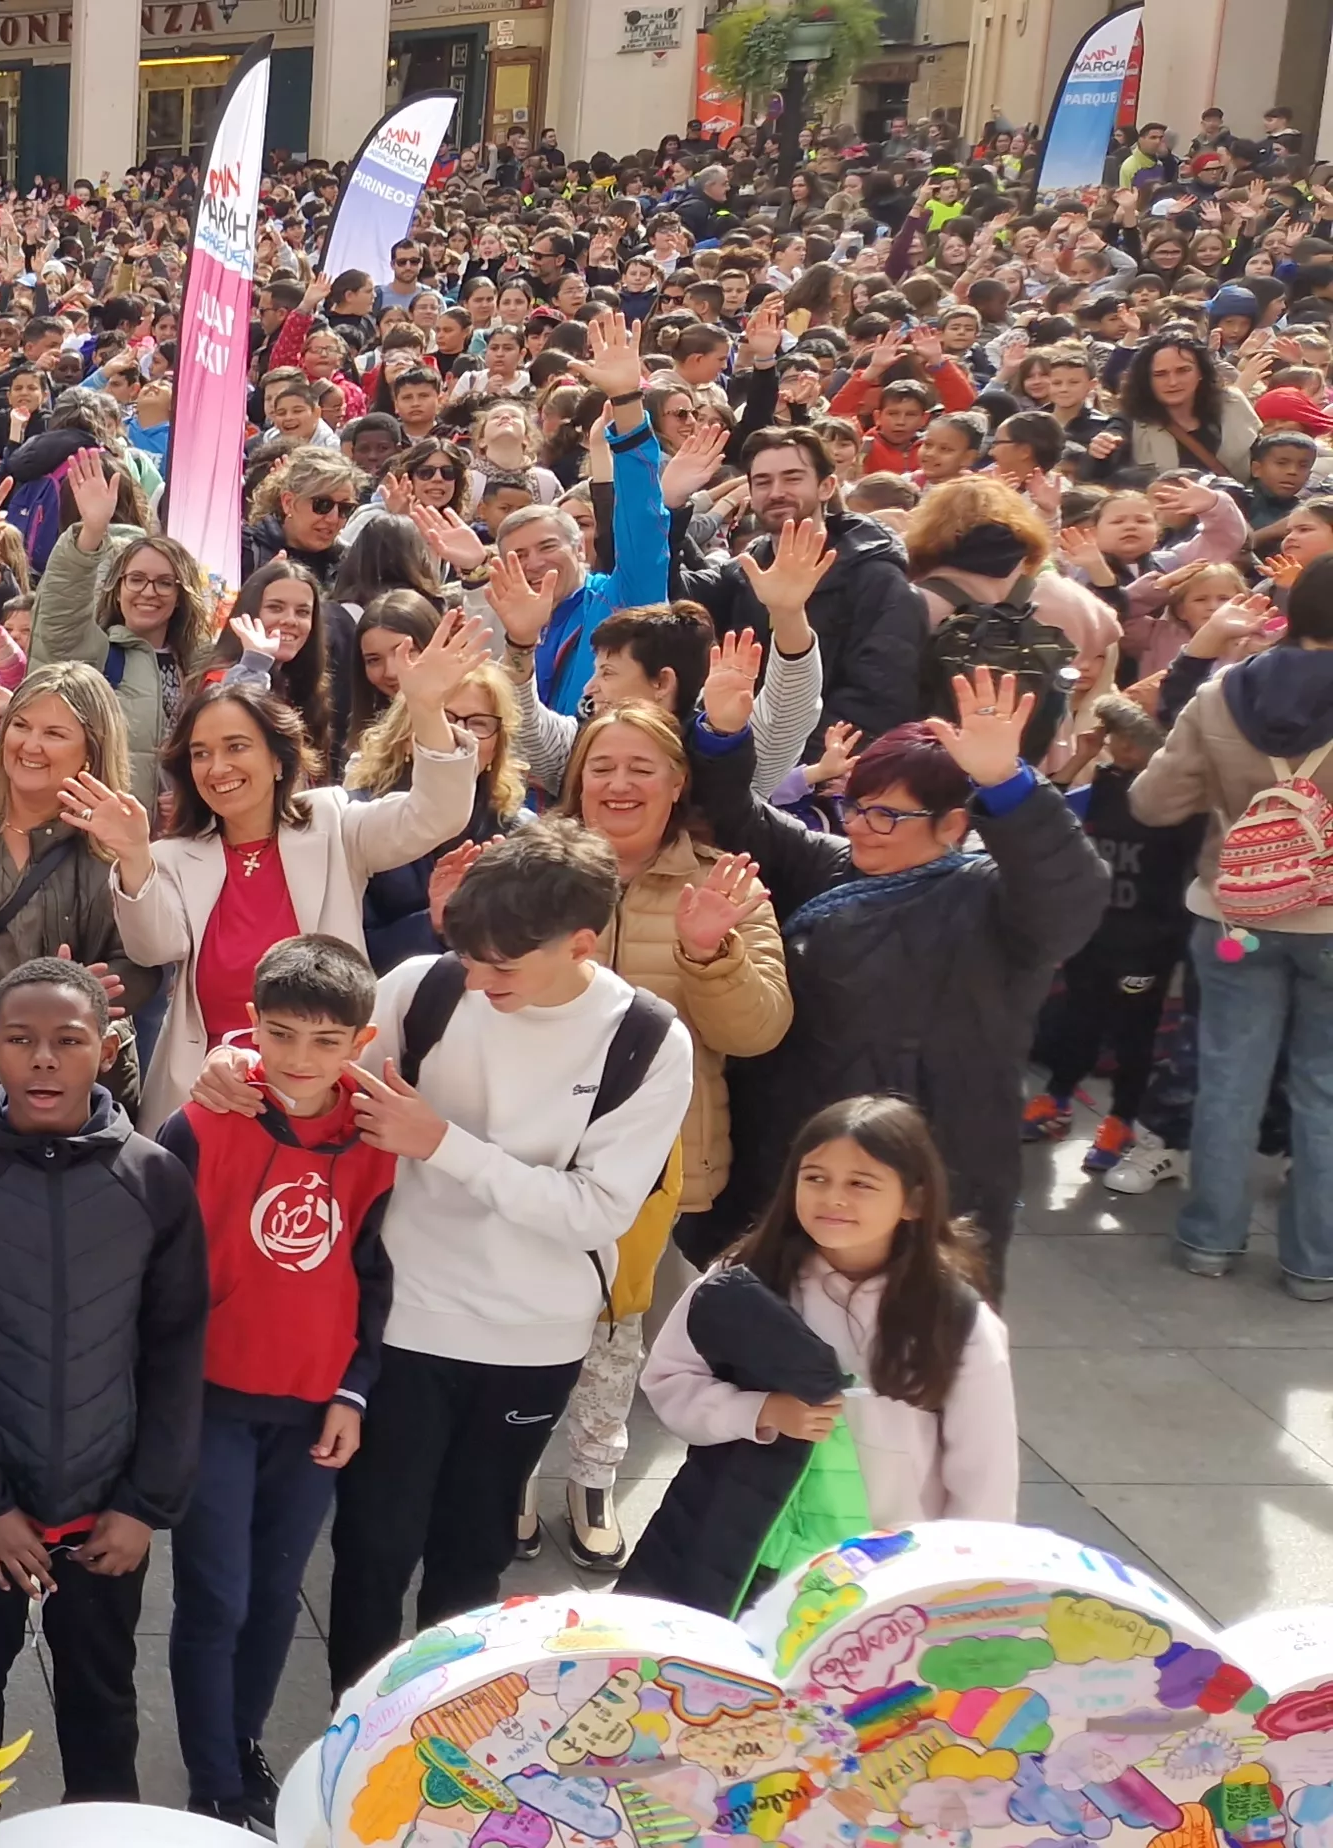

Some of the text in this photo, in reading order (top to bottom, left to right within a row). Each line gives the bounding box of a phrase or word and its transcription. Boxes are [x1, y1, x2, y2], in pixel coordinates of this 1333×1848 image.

[1074, 59, 1126, 72] MARCHA
[1065, 92, 1118, 107] PARQUE
[373, 134, 429, 172] MARCHA
[385, 127, 421, 147] MINI
[352, 170, 417, 208] PIRINEOS
[1062, 1602, 1158, 1651] Honesty
[819, 1612, 921, 1686] respeto
